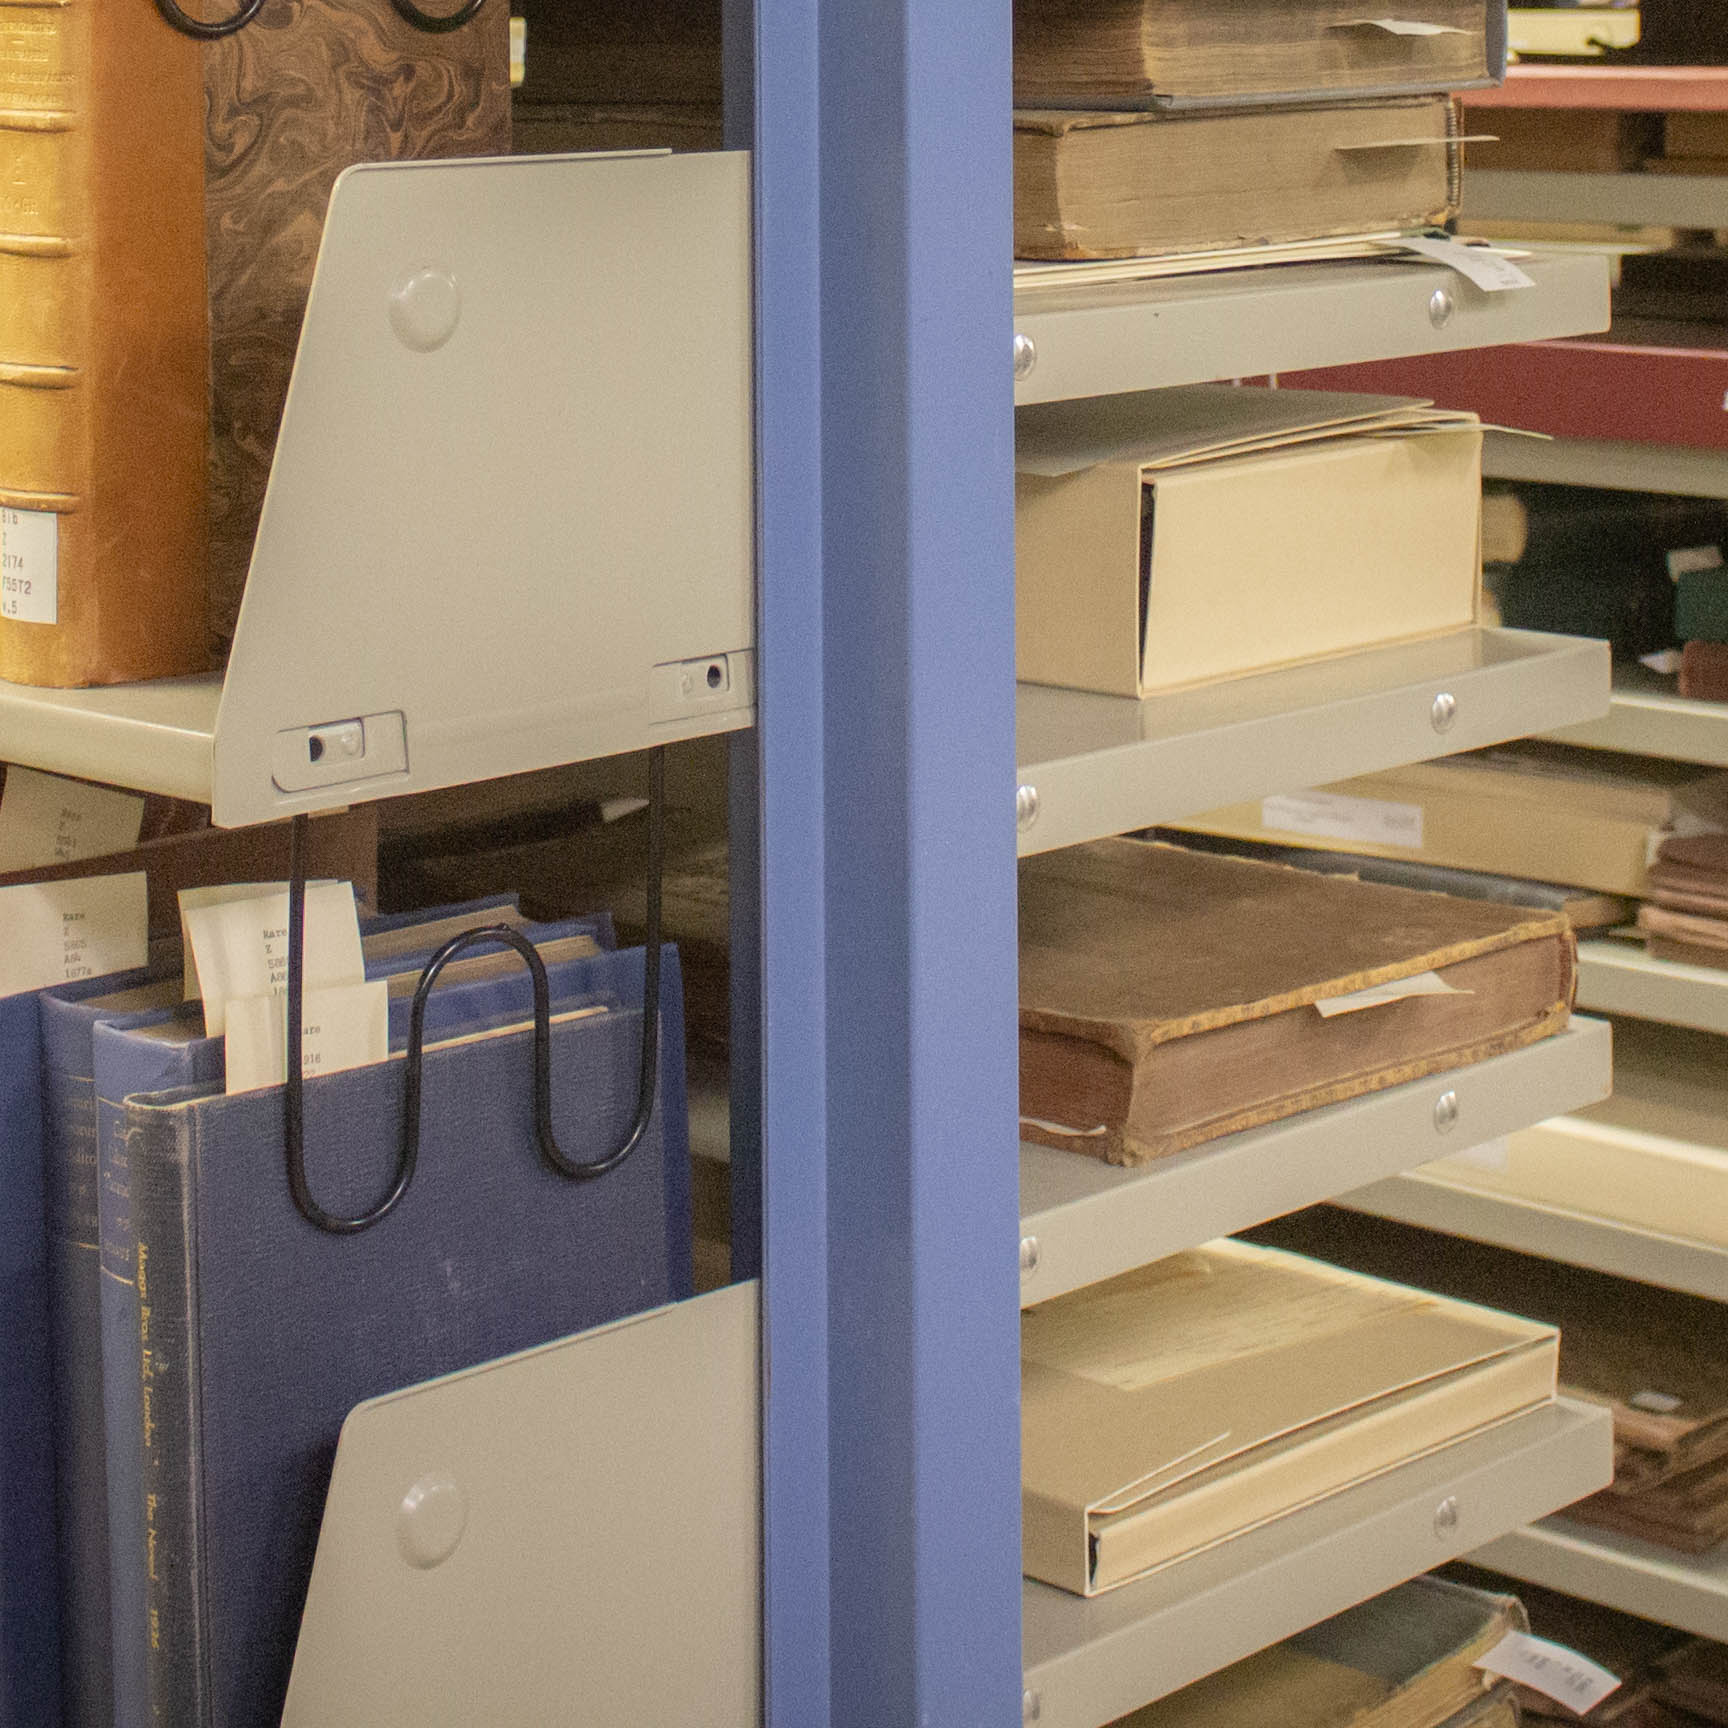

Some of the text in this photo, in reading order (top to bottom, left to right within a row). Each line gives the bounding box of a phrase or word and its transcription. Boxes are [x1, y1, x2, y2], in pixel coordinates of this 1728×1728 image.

[2, 553, 24, 570] 2174
[2, 576, 32, 596] F55T2
[144, 1385, 157, 1448] London
